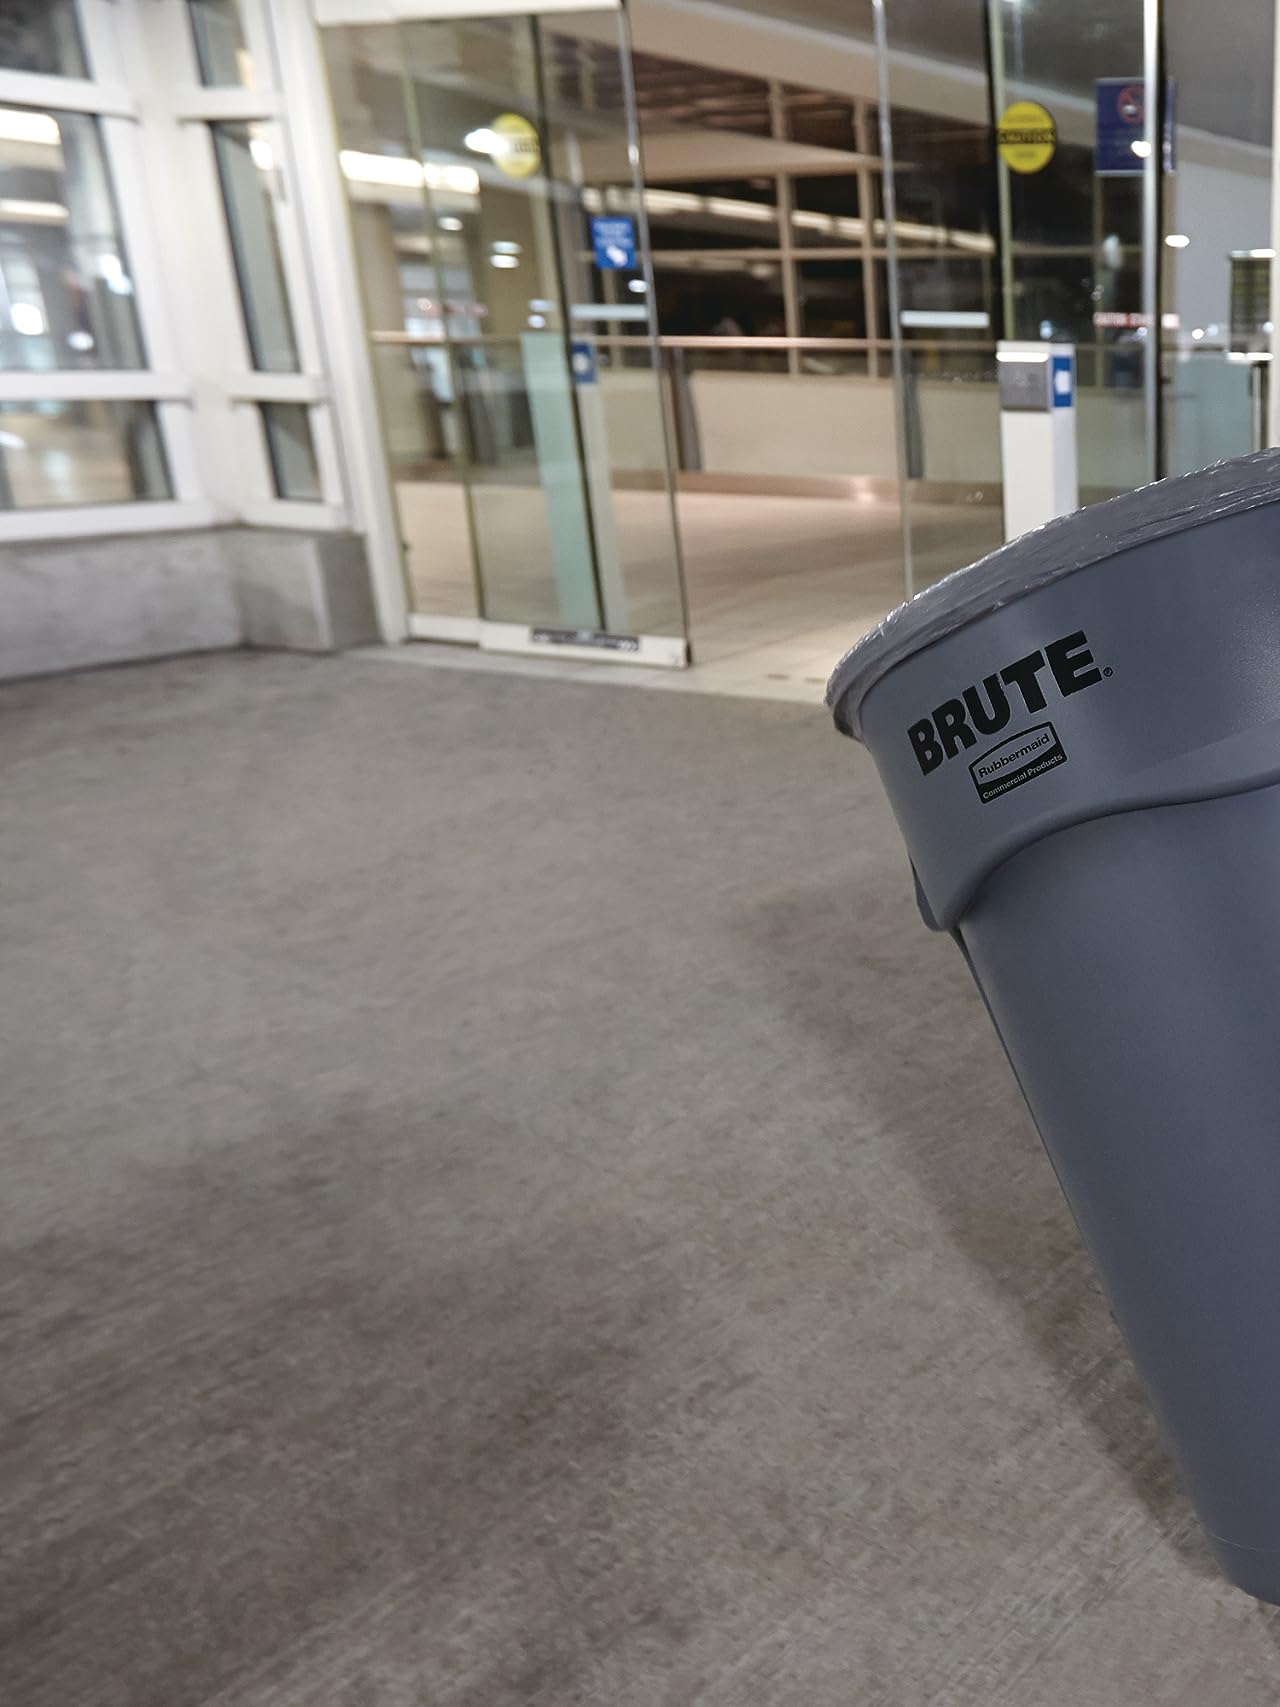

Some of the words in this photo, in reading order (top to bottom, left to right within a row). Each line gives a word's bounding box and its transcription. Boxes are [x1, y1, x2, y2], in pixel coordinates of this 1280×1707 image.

[978, 733, 1050, 778] Rubbermaid
[982, 771, 1027, 799] Commercial
[1027, 754, 1063, 776] Products
